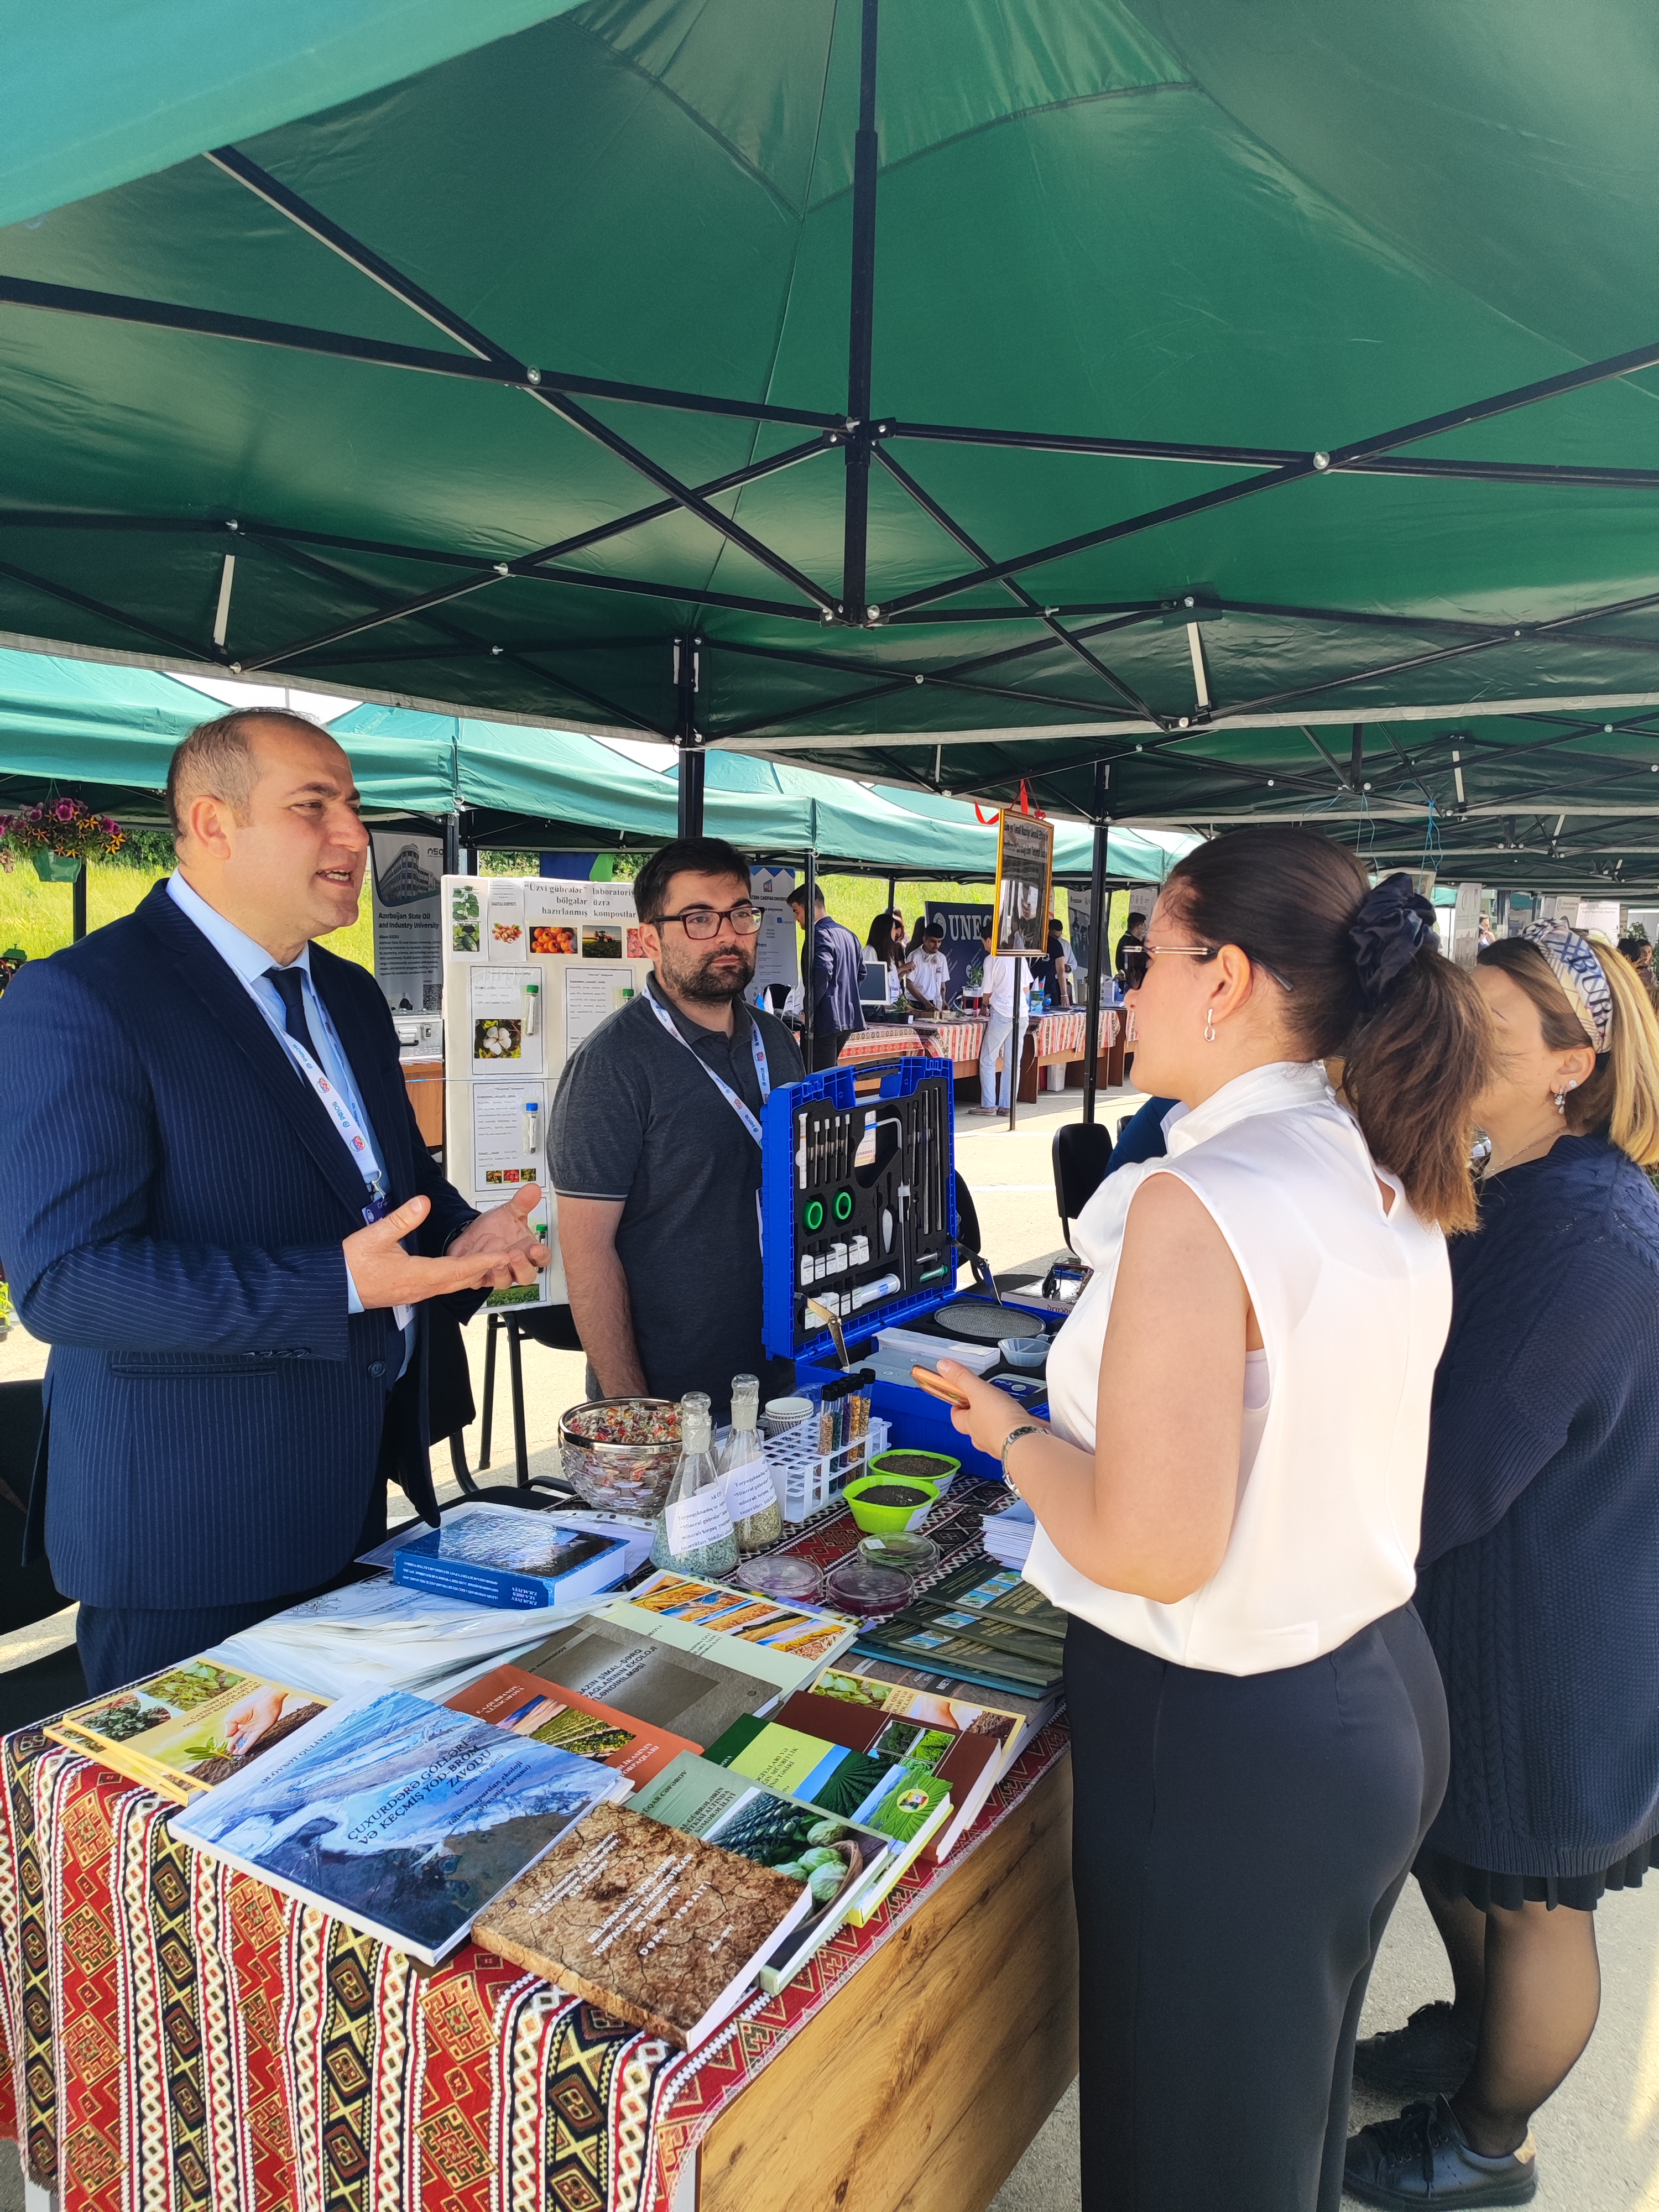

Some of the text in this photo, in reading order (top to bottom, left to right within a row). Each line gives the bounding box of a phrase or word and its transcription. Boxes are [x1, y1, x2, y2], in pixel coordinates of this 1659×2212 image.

[542, 907, 588, 917] hazırlanmış
[556, 896, 587, 906] bölgələr
[414, 921, 439, 930] University
[292, 1044, 307, 1062] PRIOR
[332, 1101, 346, 1121] PRIOR
[536, 1646, 566, 1668] MƏMMƏDOV
[597, 1648, 643, 1680] ŞİMAL-ŞƏRQ
[626, 1646, 658, 1668] EKOLOJİ
[446, 1749, 491, 1788] ZAVODU
[474, 1780, 501, 1804] aparılan
[501, 1760, 523, 1781] ekoloji
[347, 1739, 469, 1841] ÇUXURDƏRƏ GÖLLƏRİ
[379, 1791, 425, 1830] KEÇMİŞ
[422, 1745, 481, 1793] YOD-BROM
[660, 1770, 687, 1797] CƏFƏROV
[695, 1792, 736, 1833] SƏMƏRƏLİLİYİ
[706, 1790, 730, 1814] ALTINDA
[633, 1885, 681, 1932] VƏ TƏSNİFATI
[592, 1906, 644, 1956] TORPAQLARIN
